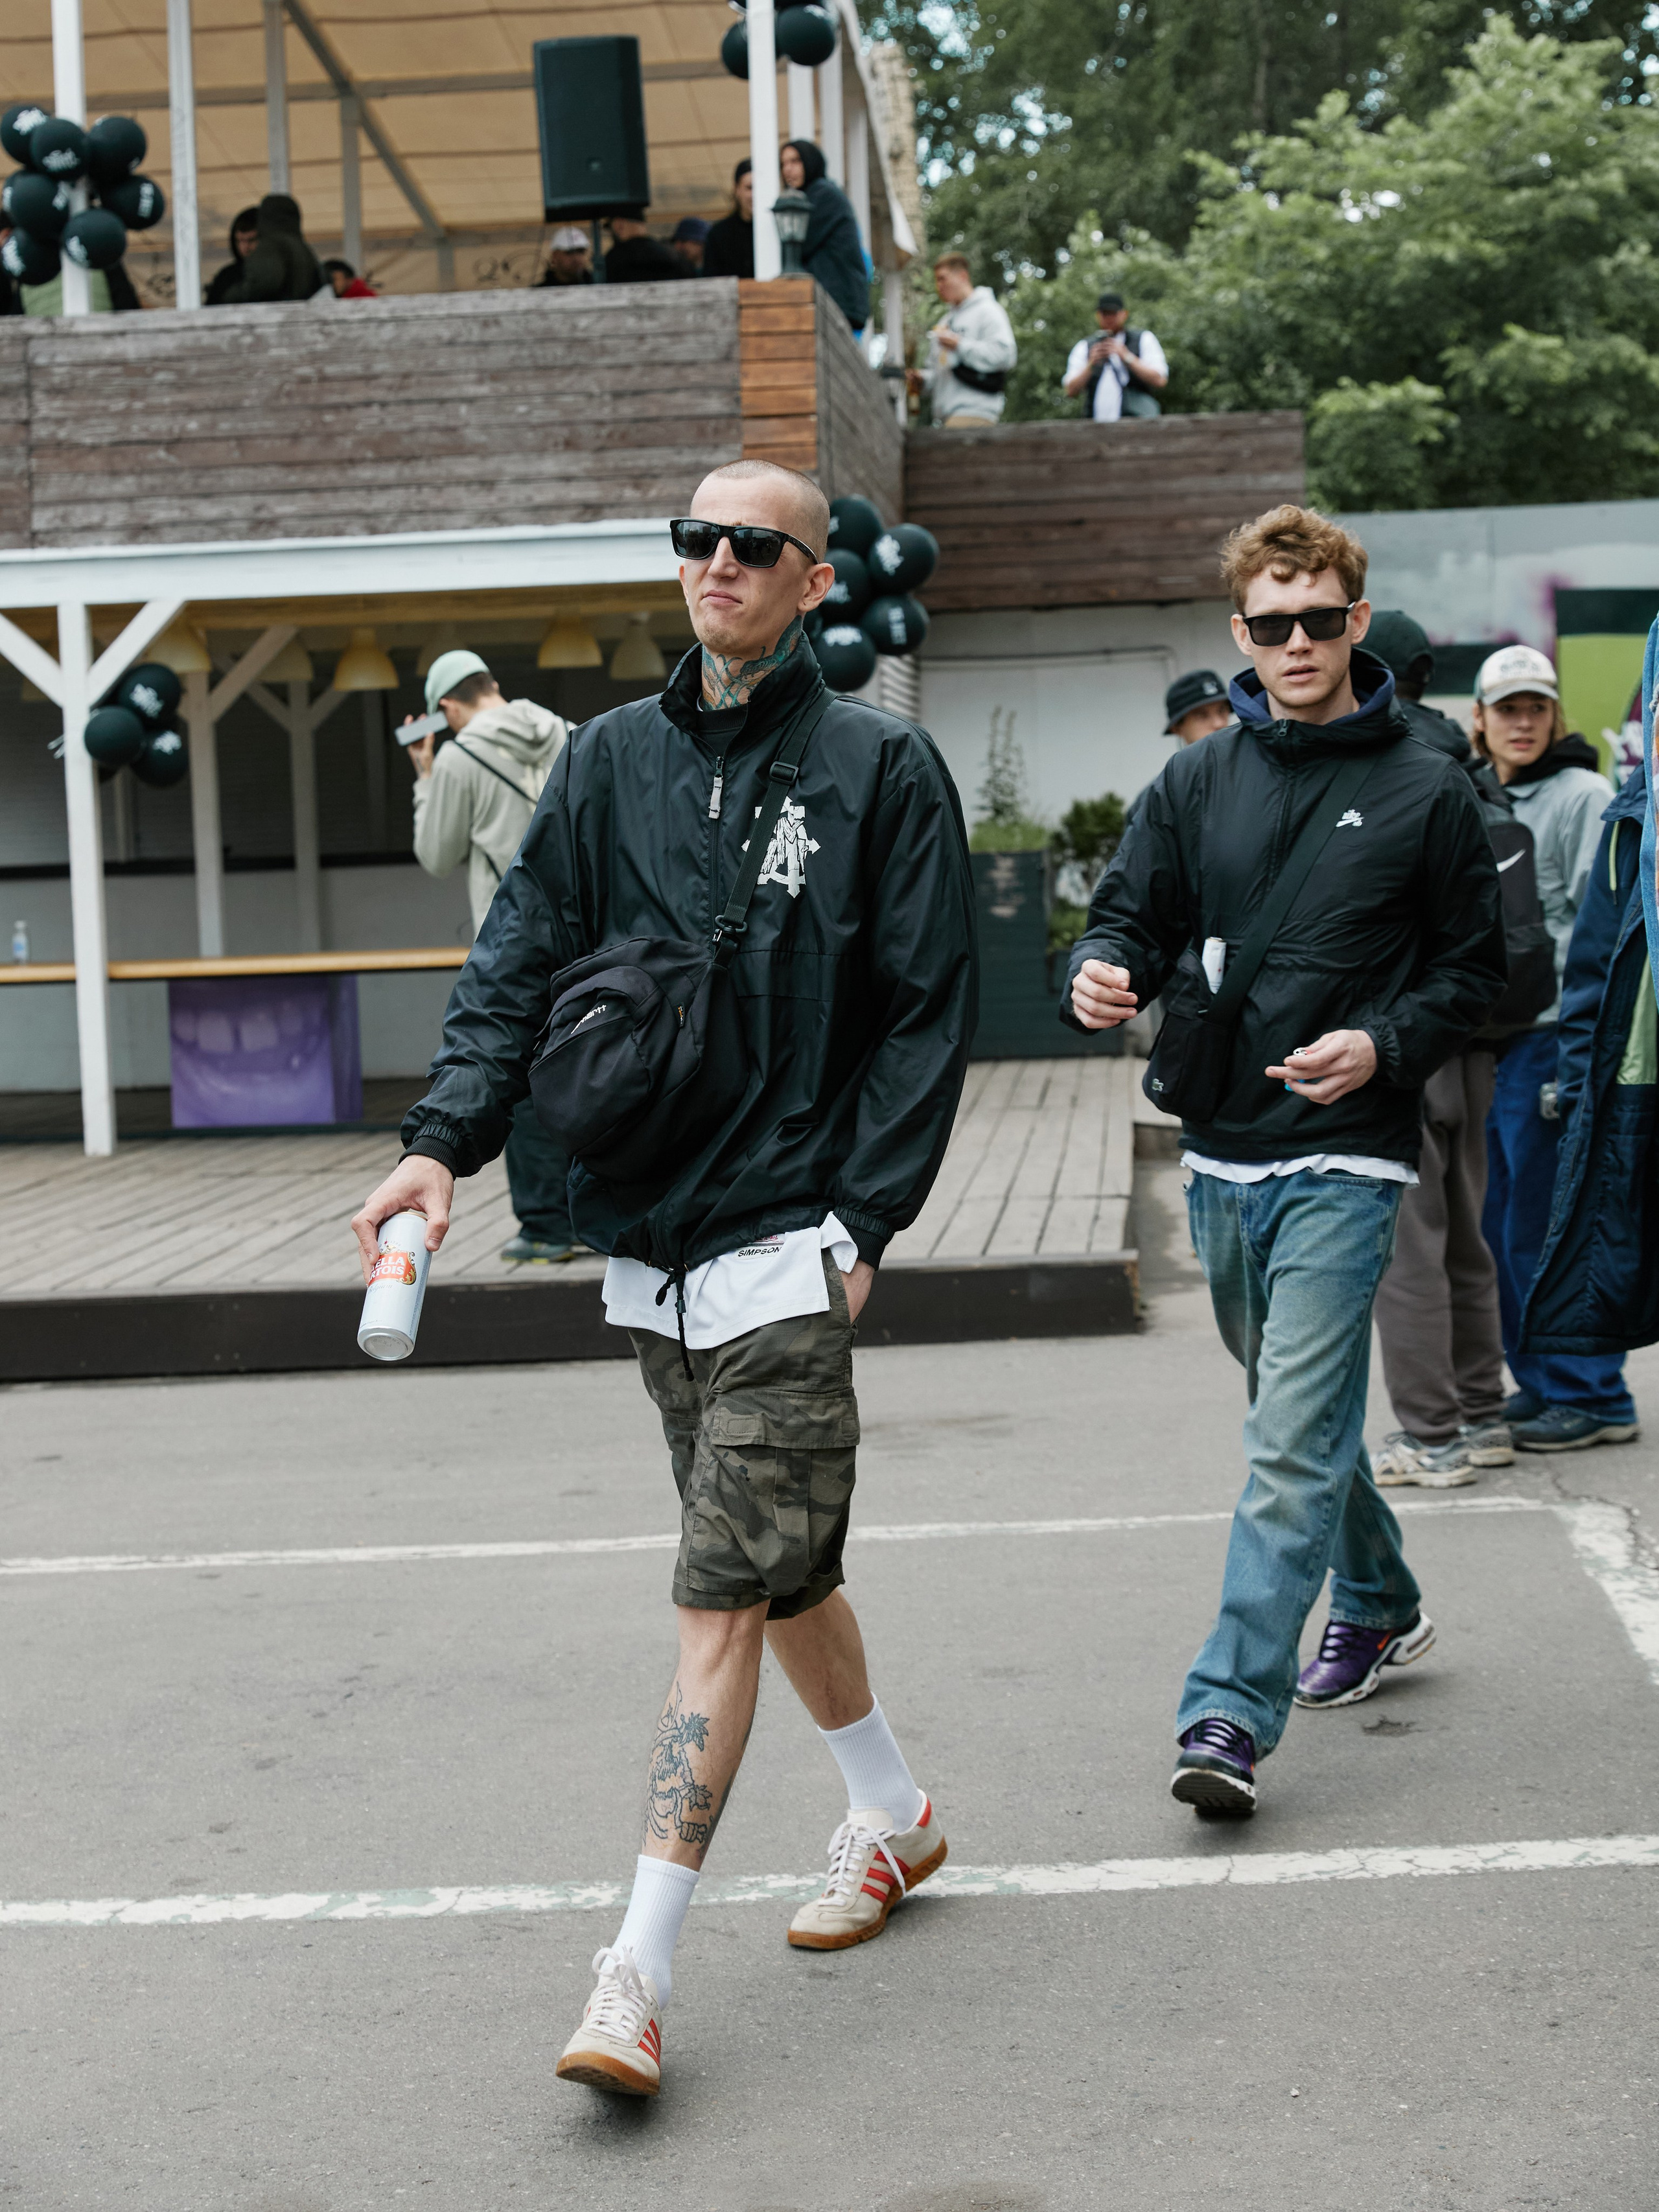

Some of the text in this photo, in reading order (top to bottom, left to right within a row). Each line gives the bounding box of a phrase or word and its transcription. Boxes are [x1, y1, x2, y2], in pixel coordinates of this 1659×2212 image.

[737, 1246, 782, 1257] SIMPSON
[371, 1256, 405, 1271] ELLA
[369, 1265, 405, 1281] RTOIS
